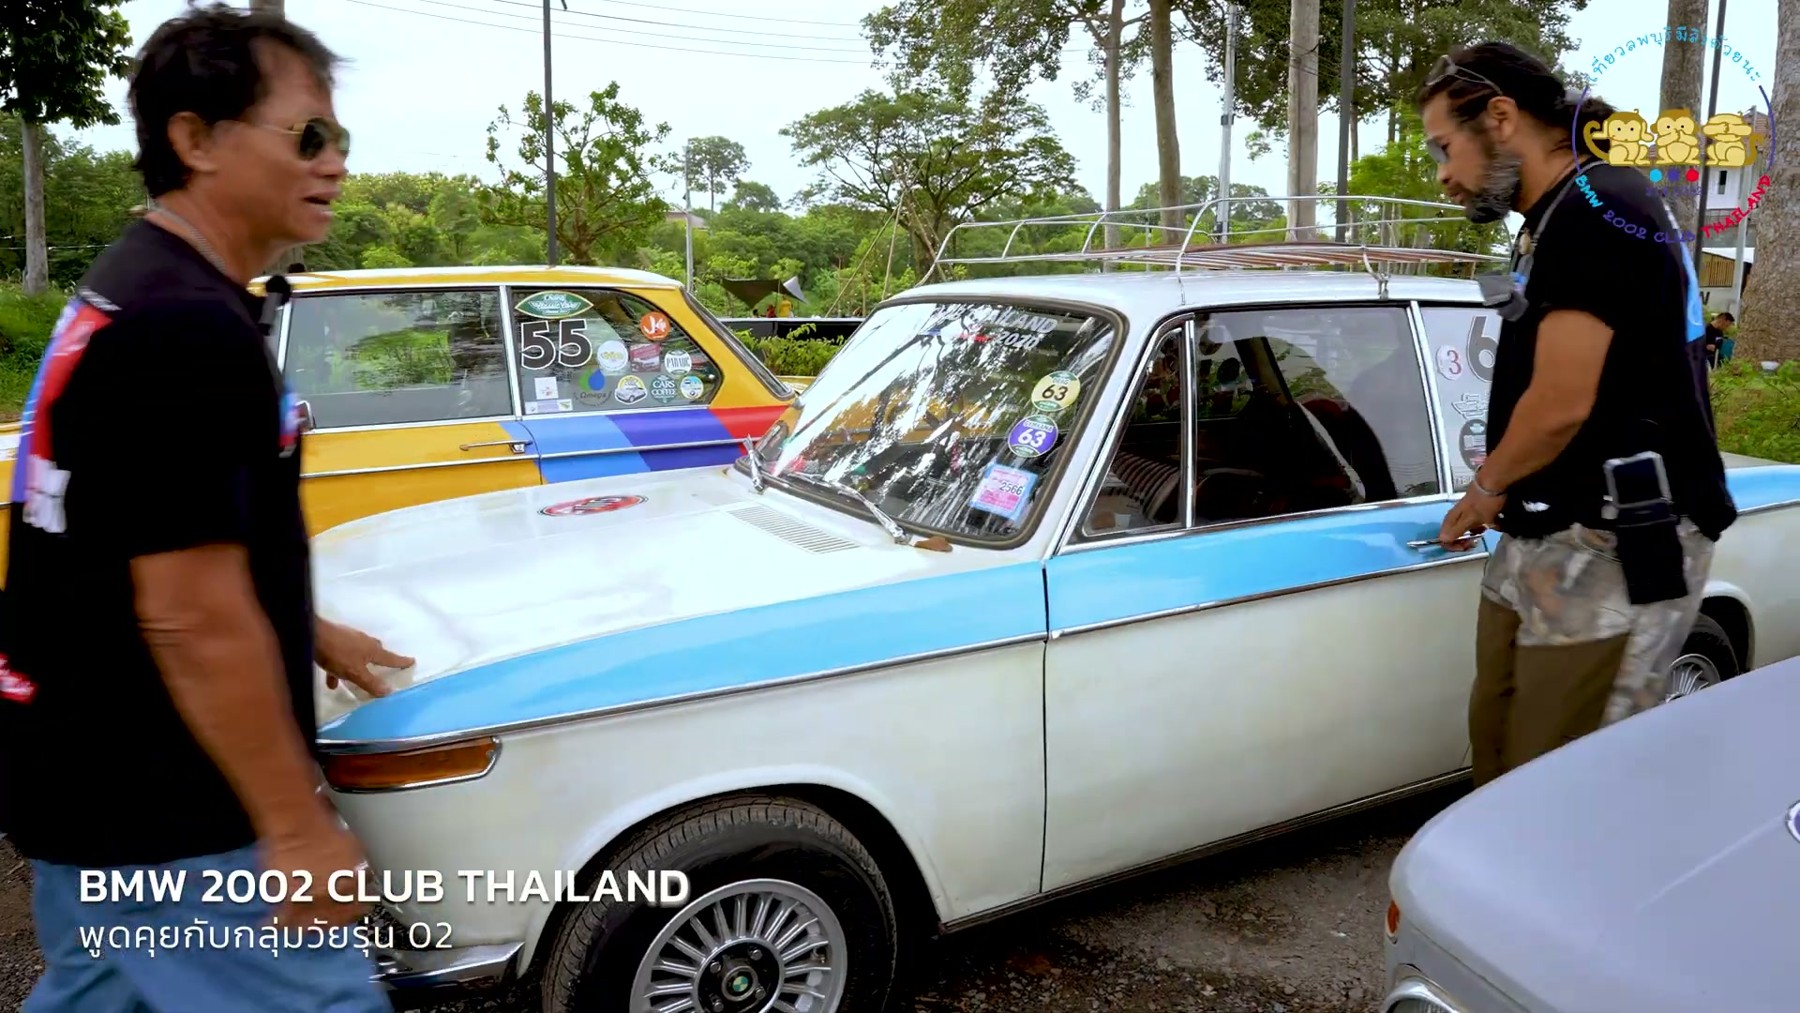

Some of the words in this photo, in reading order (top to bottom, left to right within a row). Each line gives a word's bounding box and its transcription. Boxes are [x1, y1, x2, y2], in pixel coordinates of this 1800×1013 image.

[521, 318, 593, 370] 55
[652, 380, 676, 389] CARS
[1042, 384, 1068, 401] 63
[1018, 428, 1047, 448] 63
[999, 482, 1023, 496] 2566
